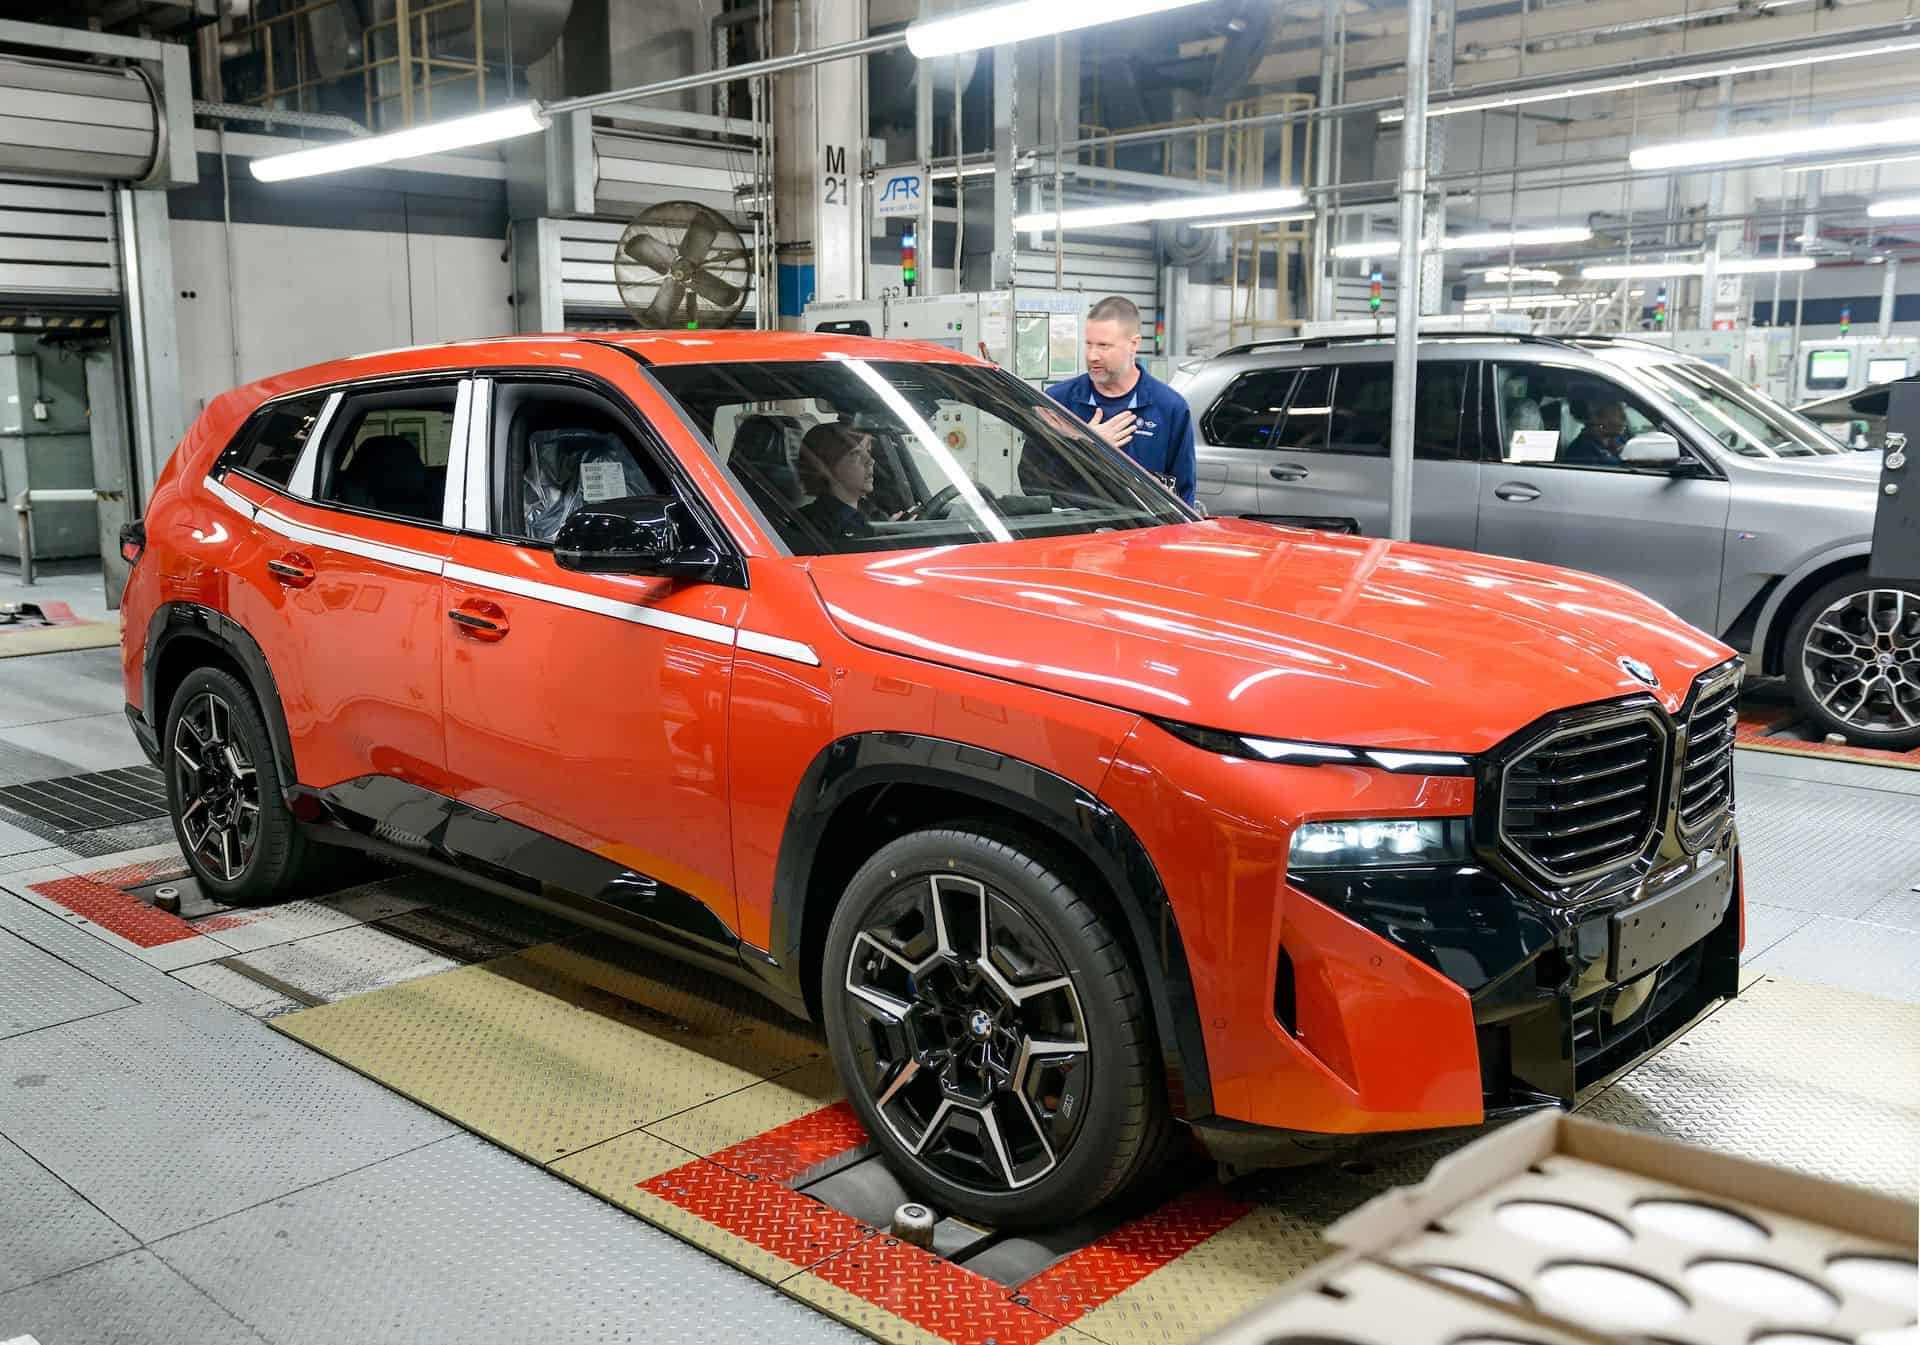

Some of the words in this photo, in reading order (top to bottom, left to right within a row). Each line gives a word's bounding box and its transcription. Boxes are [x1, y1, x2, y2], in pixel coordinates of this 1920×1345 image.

[826, 145, 845, 175] M
[825, 177, 847, 206] 21
[880, 176, 920, 201] SAR
